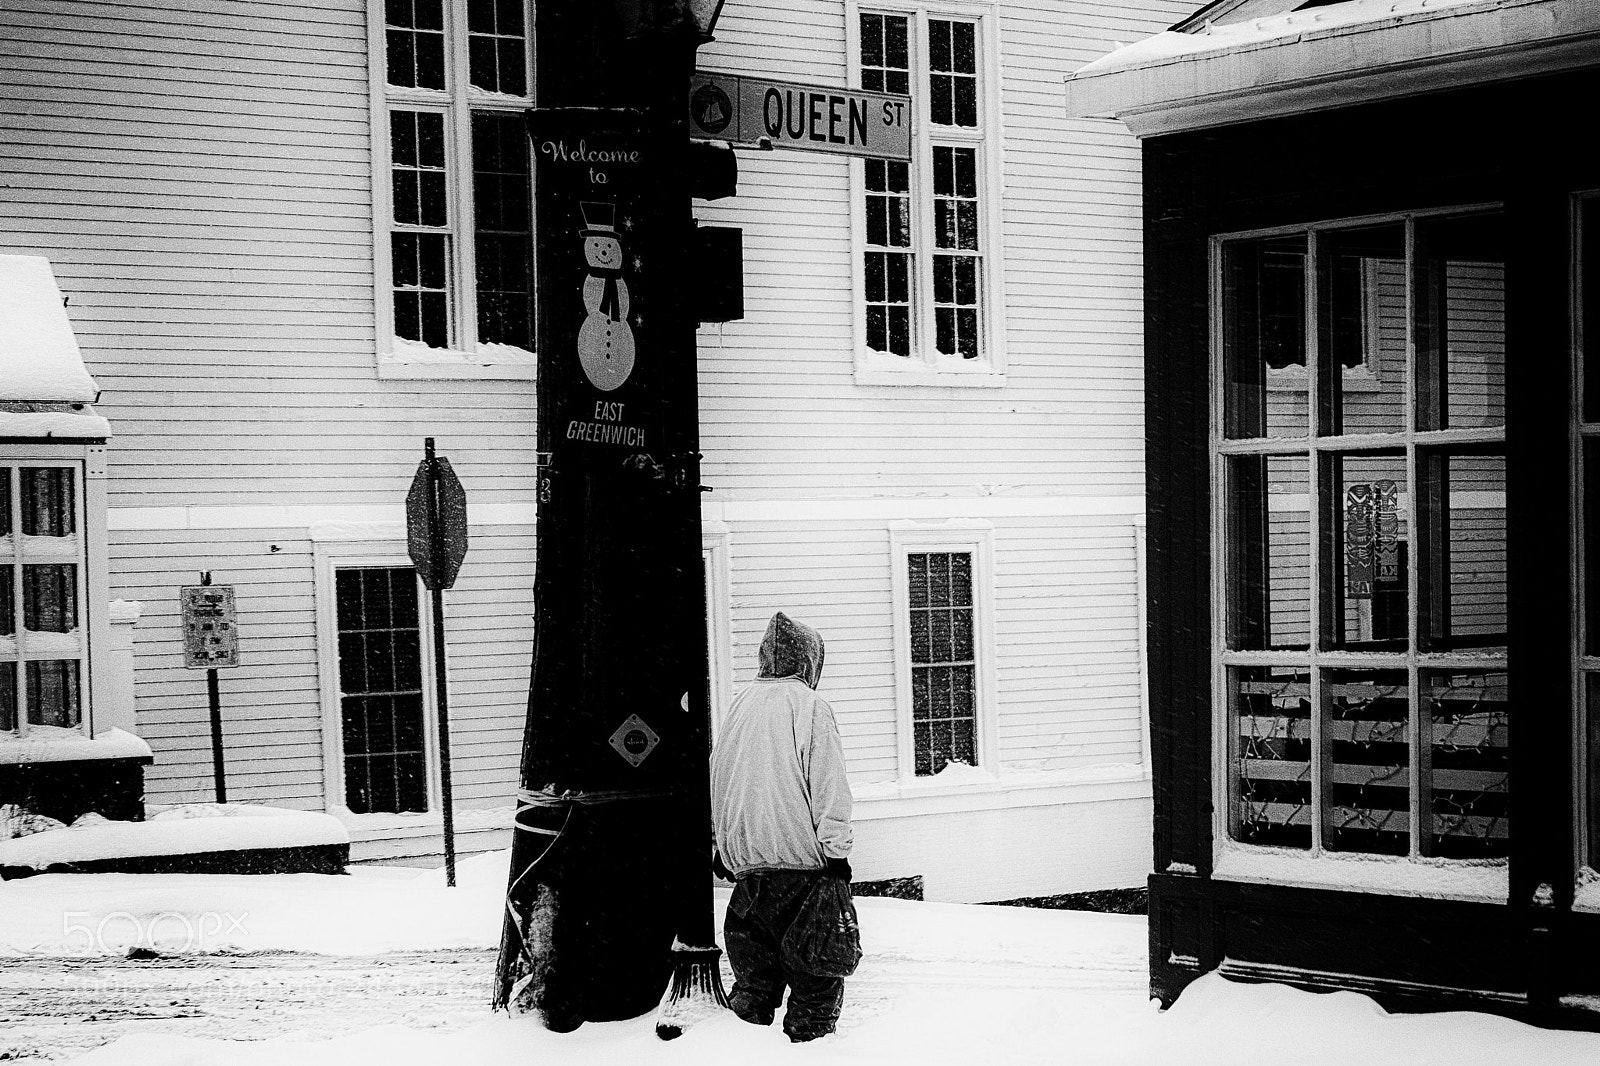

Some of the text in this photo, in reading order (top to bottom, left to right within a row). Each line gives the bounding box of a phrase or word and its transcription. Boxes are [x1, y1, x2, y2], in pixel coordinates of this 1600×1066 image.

[763, 87, 905, 147] QUEEN ST
[541, 139, 641, 163] Welcome
[589, 167, 609, 184] to
[594, 400, 625, 422] EAST
[566, 420, 645, 447] GREENWICH
